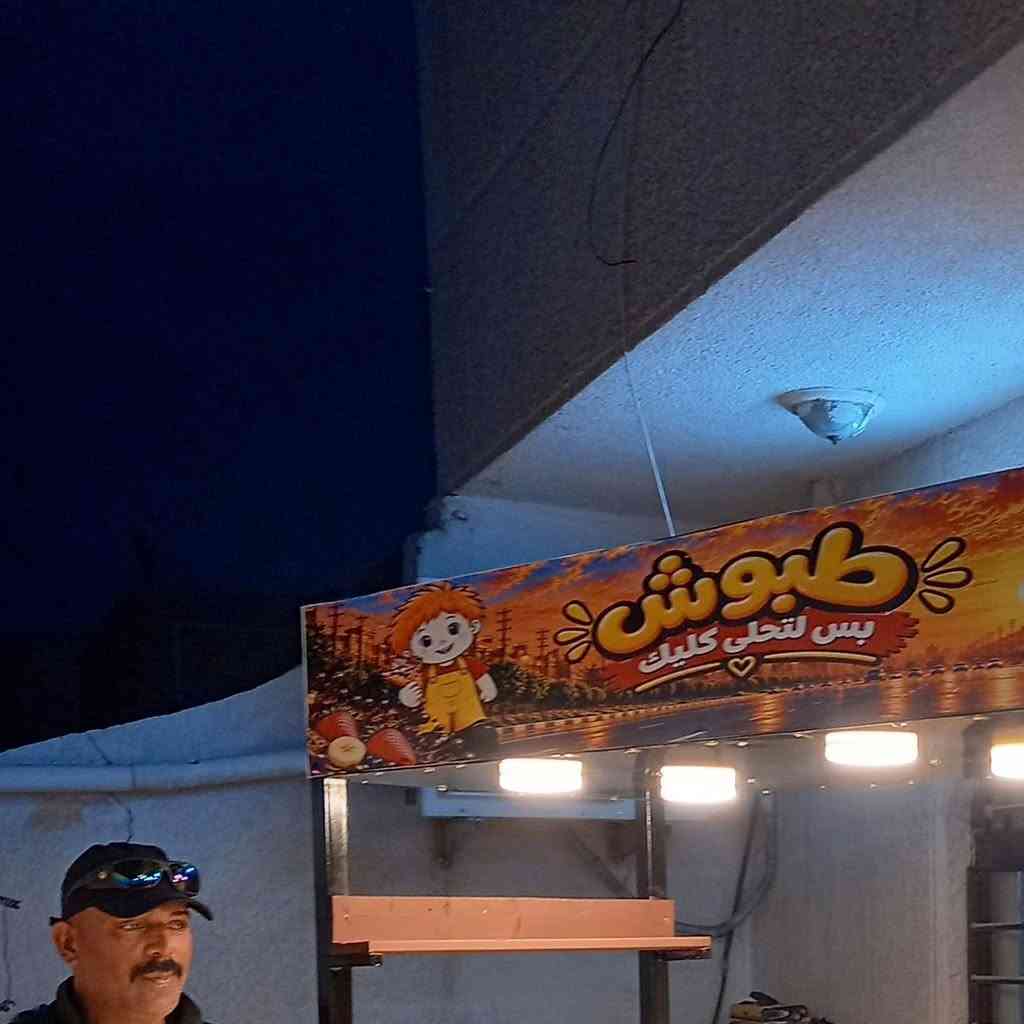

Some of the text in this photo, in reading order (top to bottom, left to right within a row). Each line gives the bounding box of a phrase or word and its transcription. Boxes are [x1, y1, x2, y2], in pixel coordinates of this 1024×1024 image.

[593, 522, 918, 658] طبوش
[638, 627, 721, 675] كليك
[811, 619, 875, 646] بس
